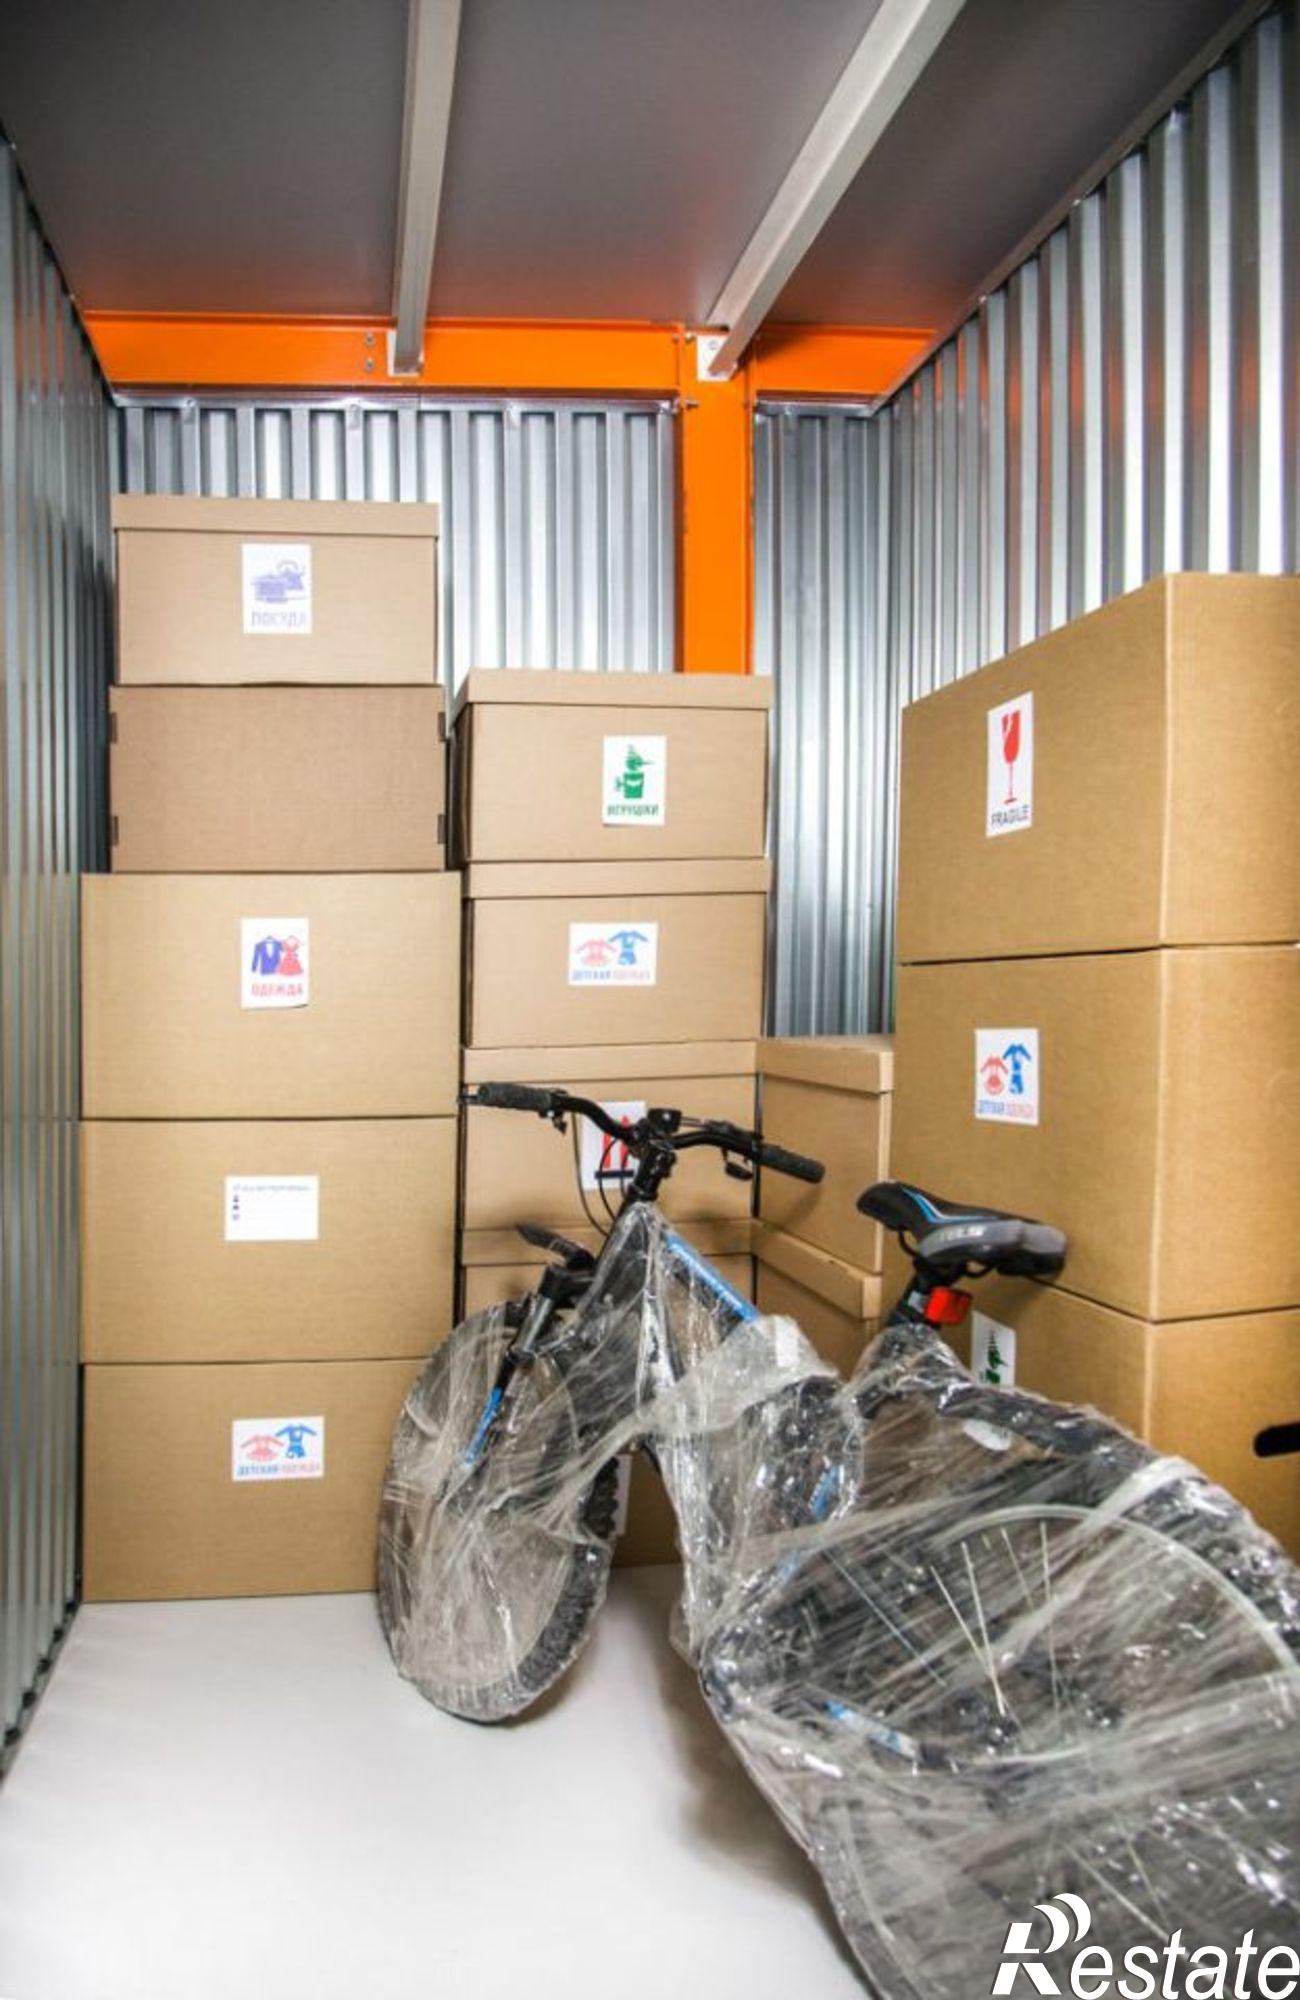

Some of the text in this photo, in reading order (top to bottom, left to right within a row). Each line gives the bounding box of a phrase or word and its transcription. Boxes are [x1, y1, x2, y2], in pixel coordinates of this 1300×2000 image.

[251, 610, 307, 628] ПОСУДА
[607, 803, 659, 817] ИГРУШКИ
[990, 804, 1030, 827] FRAGILE
[251, 982, 303, 998] ОДЕЖДА
